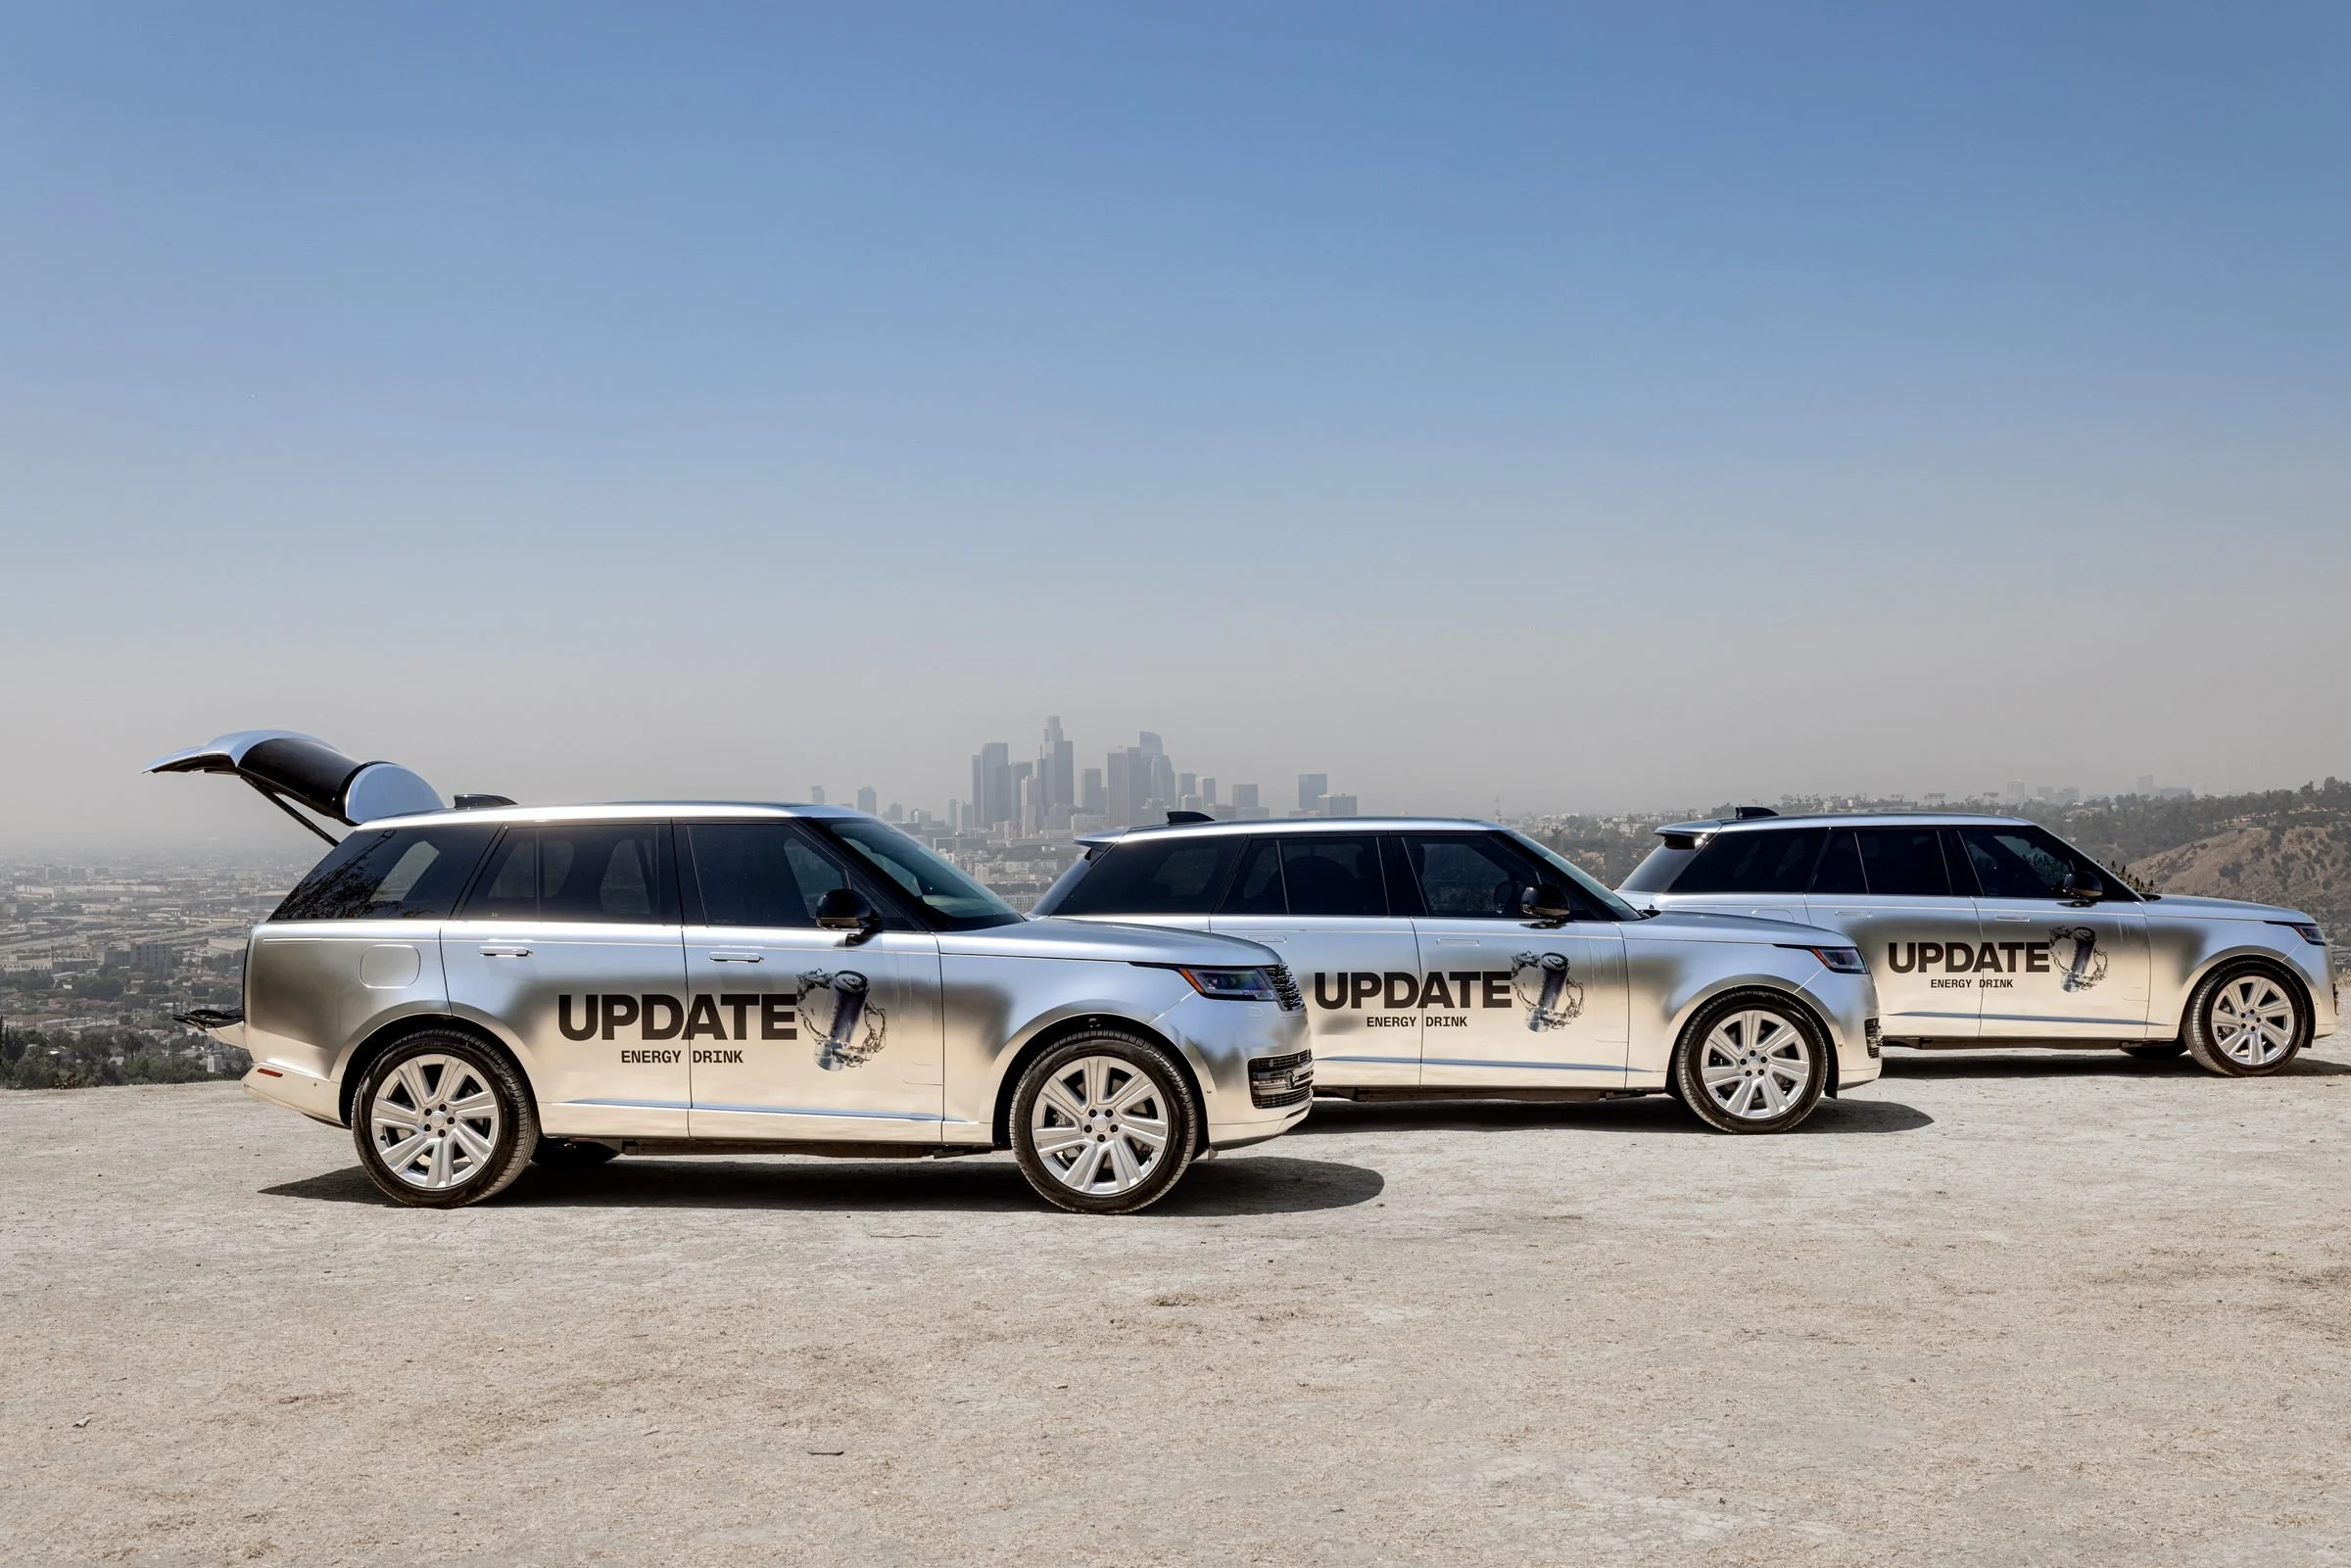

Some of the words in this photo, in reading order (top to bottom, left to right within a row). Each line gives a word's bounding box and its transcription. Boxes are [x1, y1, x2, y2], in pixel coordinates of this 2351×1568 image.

[1888, 942, 2049, 974] UPDATE
[1315, 972, 1511, 1009] UPDATE
[558, 994, 797, 1041] UPDATE
[1367, 1017, 1416, 1026] ENERGY
[1425, 1017, 1467, 1026] DRINK
[621, 1050, 681, 1063] ENERGY
[693, 1050, 743, 1063] DRINK
